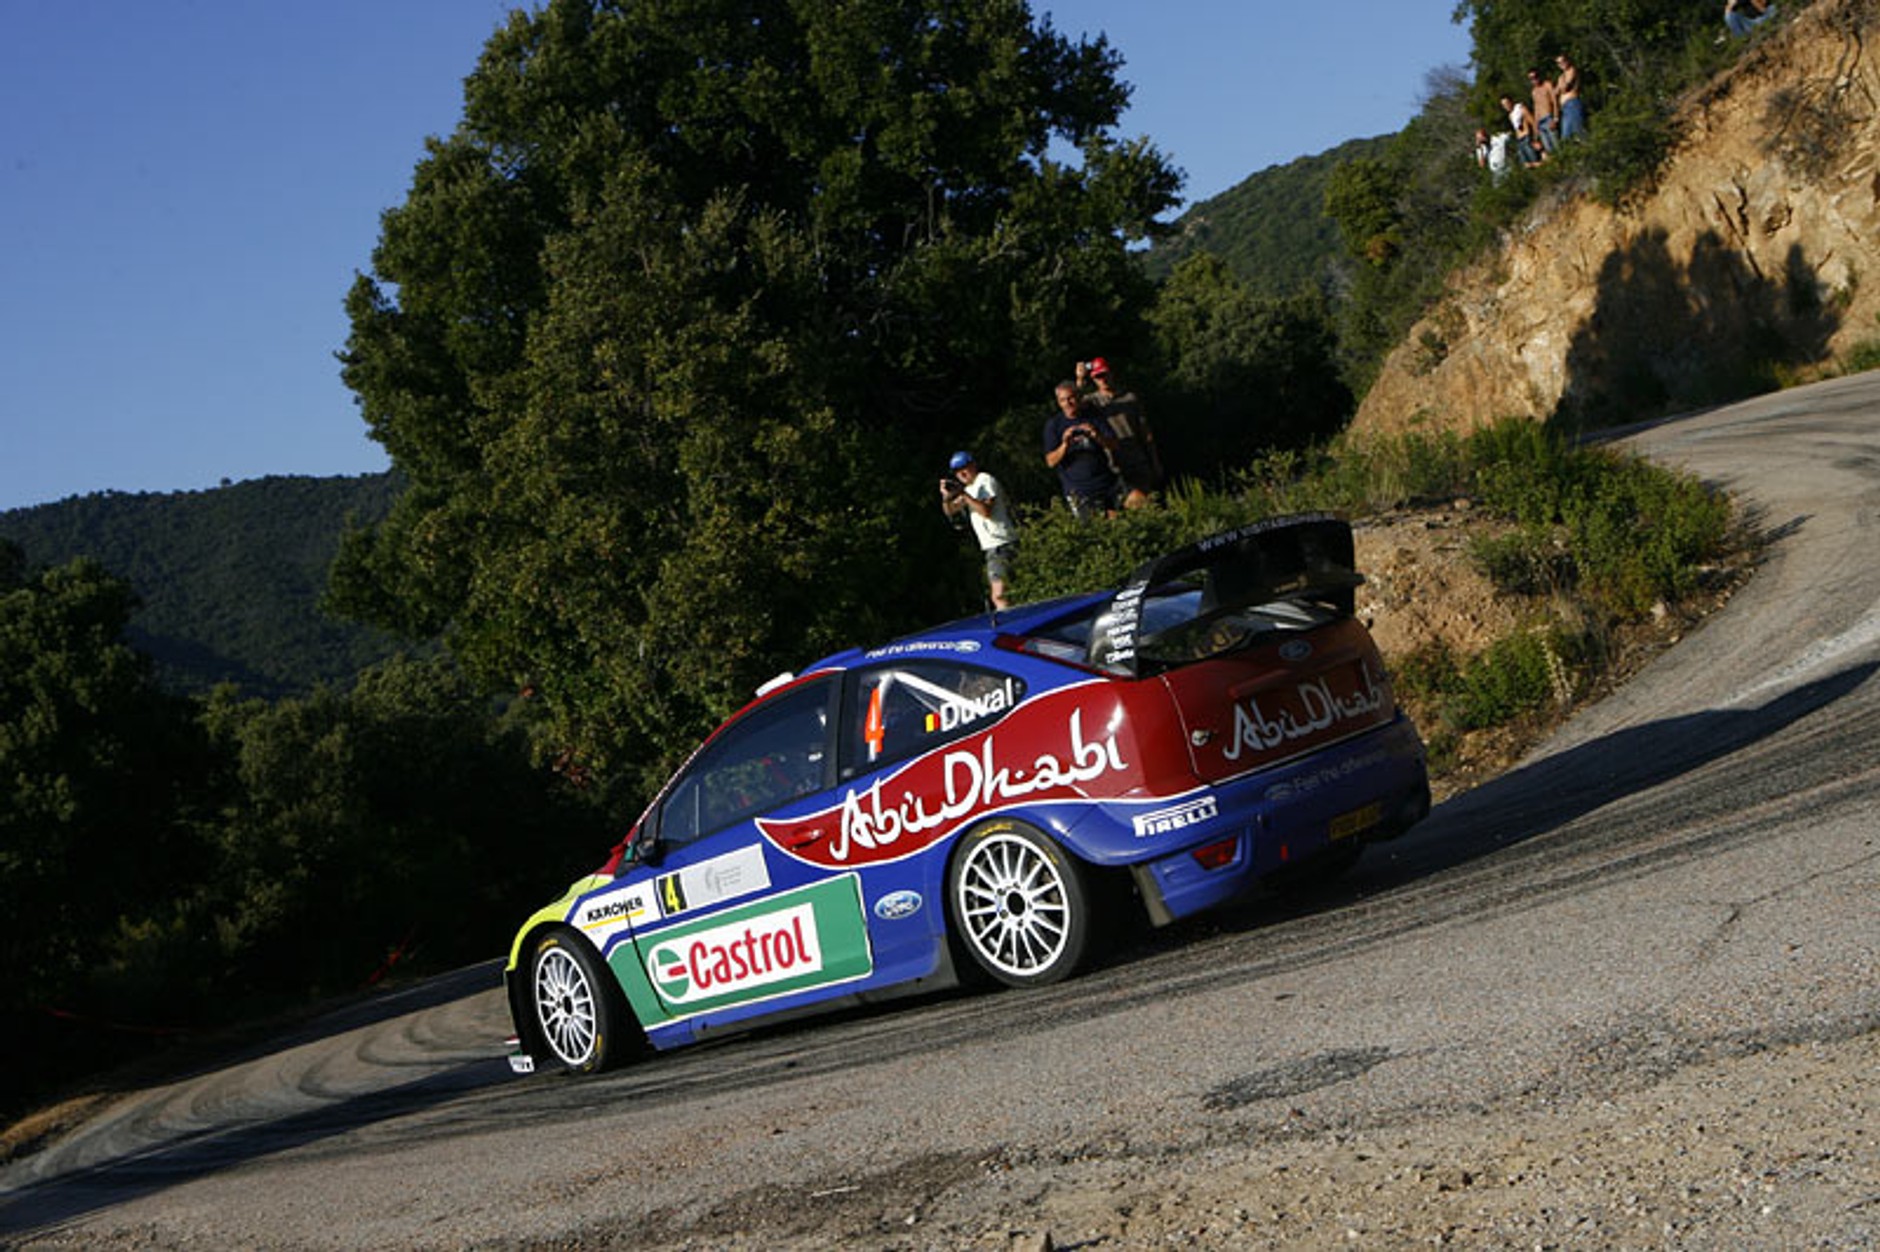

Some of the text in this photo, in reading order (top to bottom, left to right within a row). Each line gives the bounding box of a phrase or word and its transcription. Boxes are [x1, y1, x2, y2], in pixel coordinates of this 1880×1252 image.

[865, 688, 885, 753] 4
[1133, 796, 1218, 837] PIRELLI
[665, 874, 681, 912] 4
[689, 916, 812, 990] Castrol
